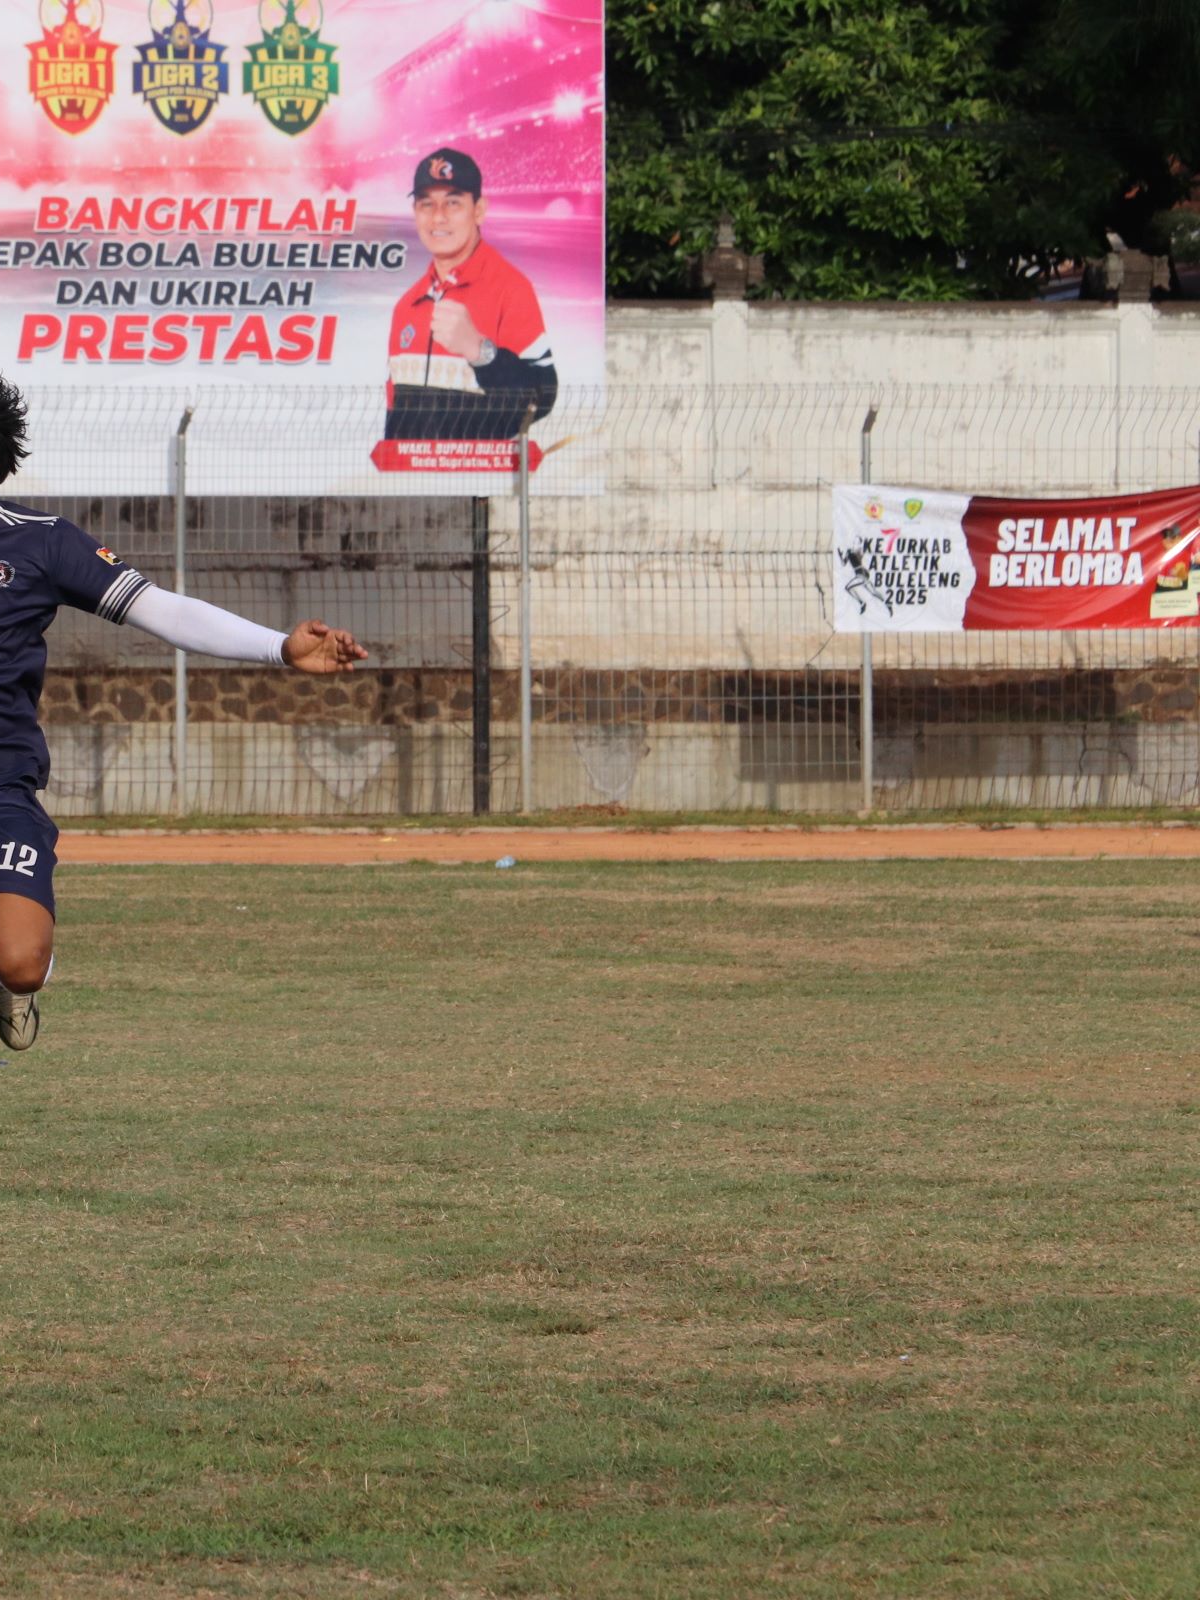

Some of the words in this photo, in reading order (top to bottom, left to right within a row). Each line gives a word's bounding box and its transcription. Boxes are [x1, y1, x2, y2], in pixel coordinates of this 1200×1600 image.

[96, 63, 106, 93] 1
[202, 64, 219, 92] 2
[312, 65, 329, 91] 3
[36, 197, 357, 232] BANGKITLAH
[99, 242, 201, 268] BOLA
[213, 243, 405, 269] BULELENG
[56, 280, 138, 305] DAN
[150, 281, 313, 306] UKIRLAH
[17, 313, 338, 364] PRESTASI
[398, 442, 432, 455] WAKIL
[435, 442, 473, 455] BUPATI
[996, 516, 1138, 553] SELAMAT
[869, 555, 941, 571] ATLETIK
[988, 551, 1145, 588] BERLOMBA
[874, 572, 961, 588] BULELENG
[885, 589, 928, 605] 2025
